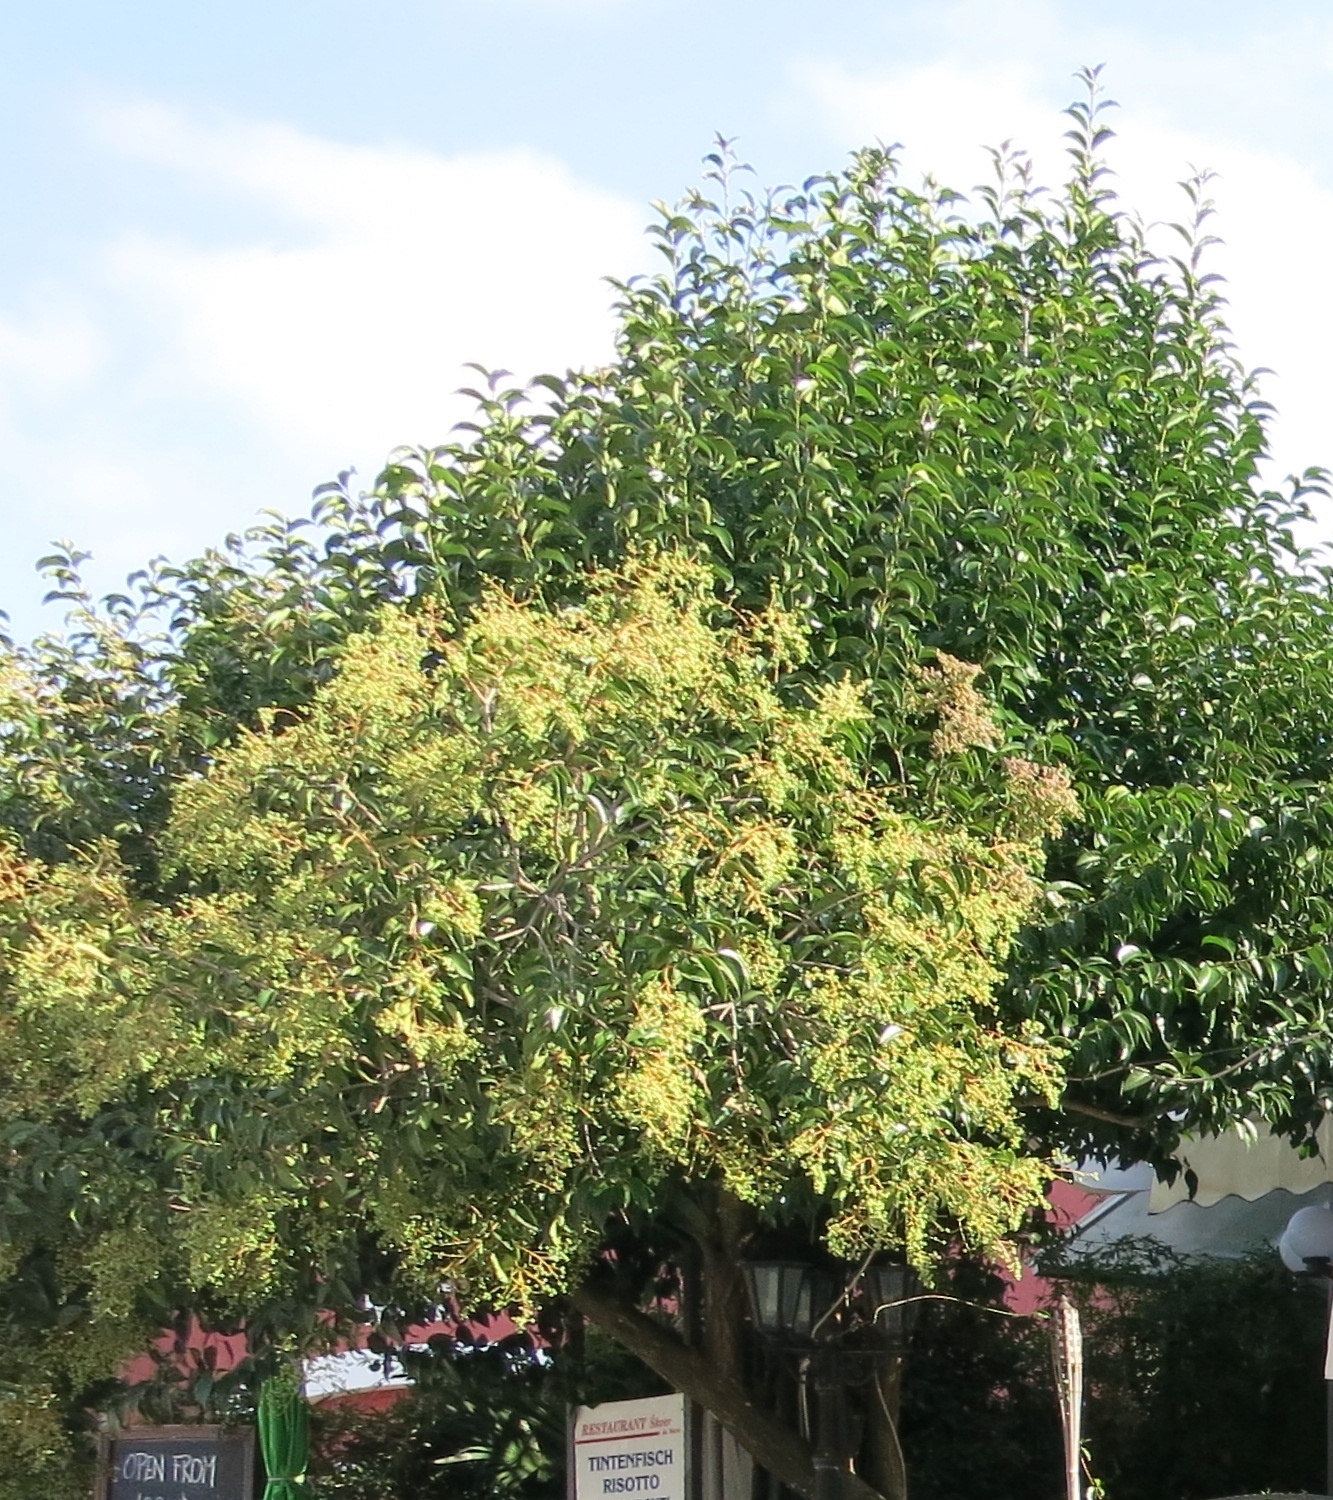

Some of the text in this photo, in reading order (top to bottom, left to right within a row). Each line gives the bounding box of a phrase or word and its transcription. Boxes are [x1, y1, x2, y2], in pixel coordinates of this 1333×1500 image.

[582, 1417, 647, 1437] RESTAURANT
[123, 1453, 218, 1488] OPEN FROM
[588, 1450, 673, 1472] TINTENFISCH
[603, 1474, 660, 1493] RISOTTO
